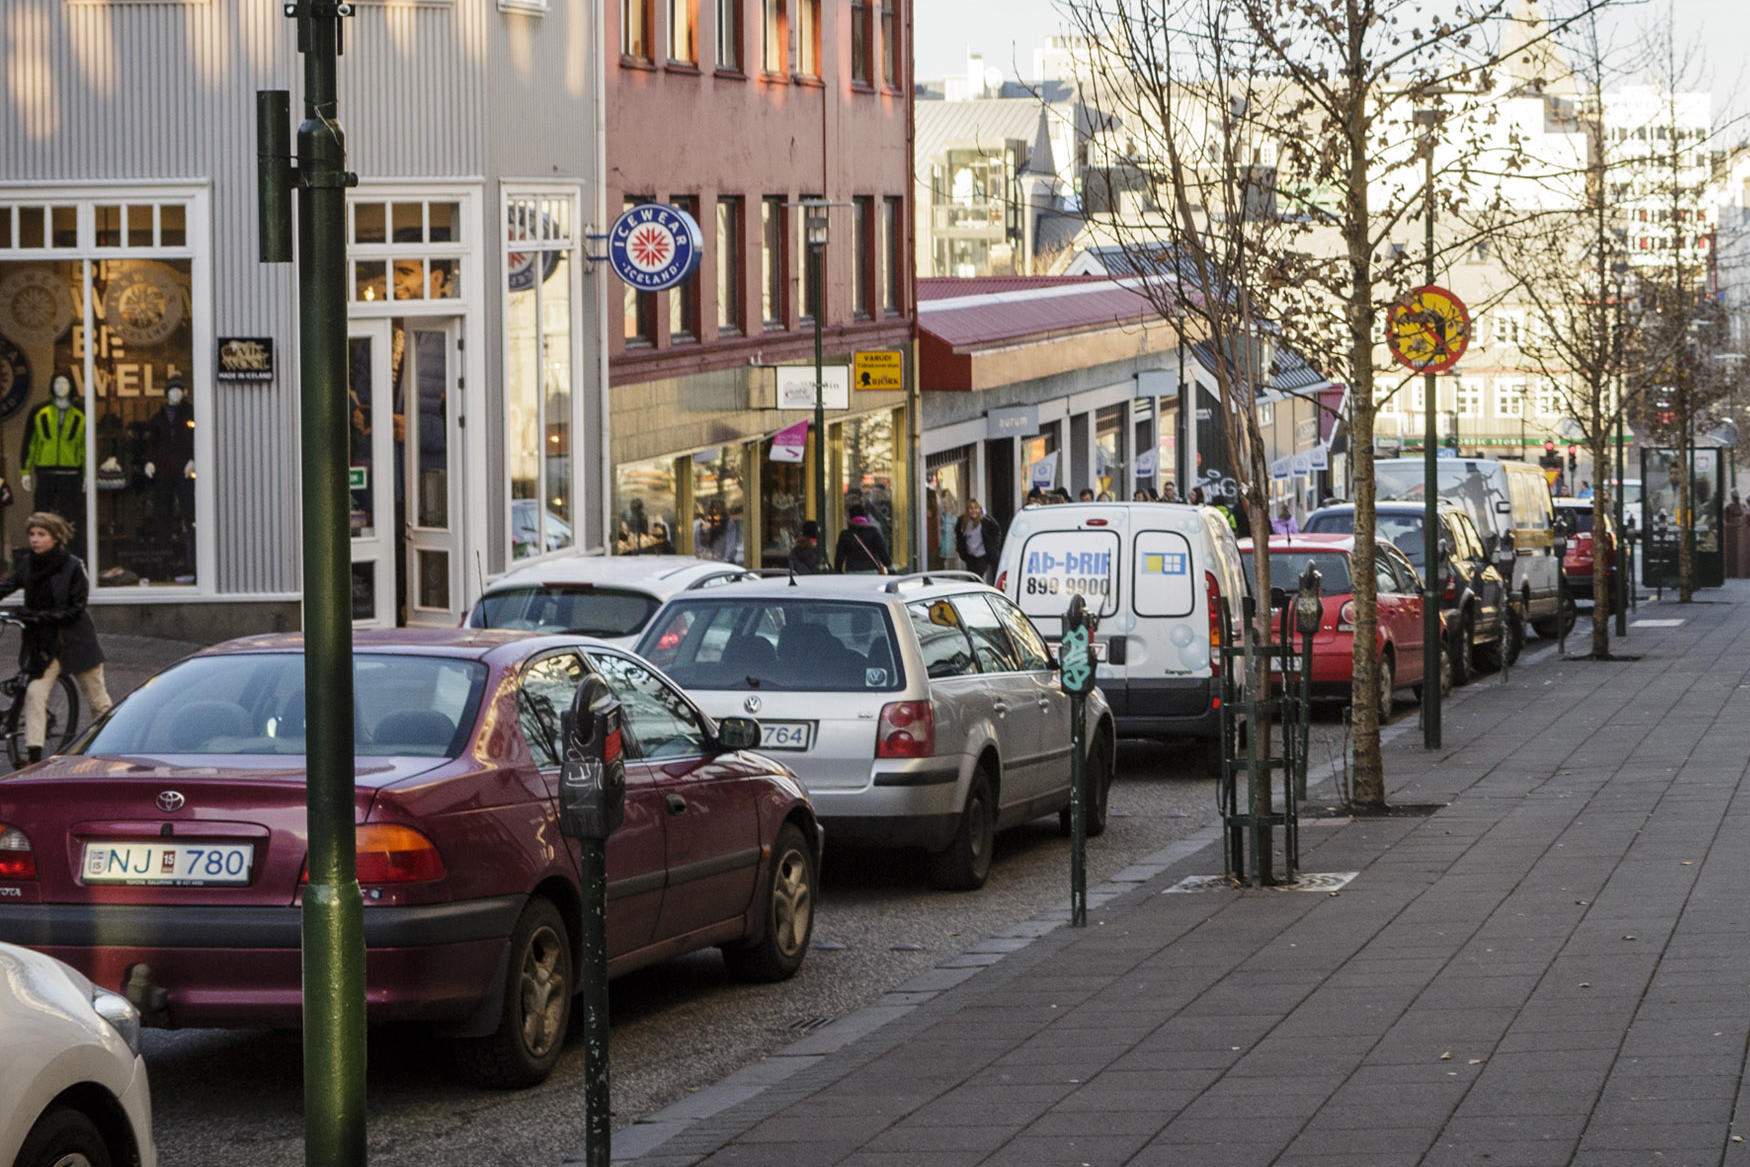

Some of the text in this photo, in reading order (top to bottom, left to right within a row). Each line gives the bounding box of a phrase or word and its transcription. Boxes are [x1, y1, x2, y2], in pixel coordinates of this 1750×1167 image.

[614, 209, 687, 247] ICEWEAR
[623, 264, 678, 284] ICELAND
[999, 416, 1028, 428] aurum
[1027, 577, 1109, 596] 899 9900
[763, 727, 803, 745] 764
[108, 849, 151, 874] NJ
[186, 850, 244, 875] 780
